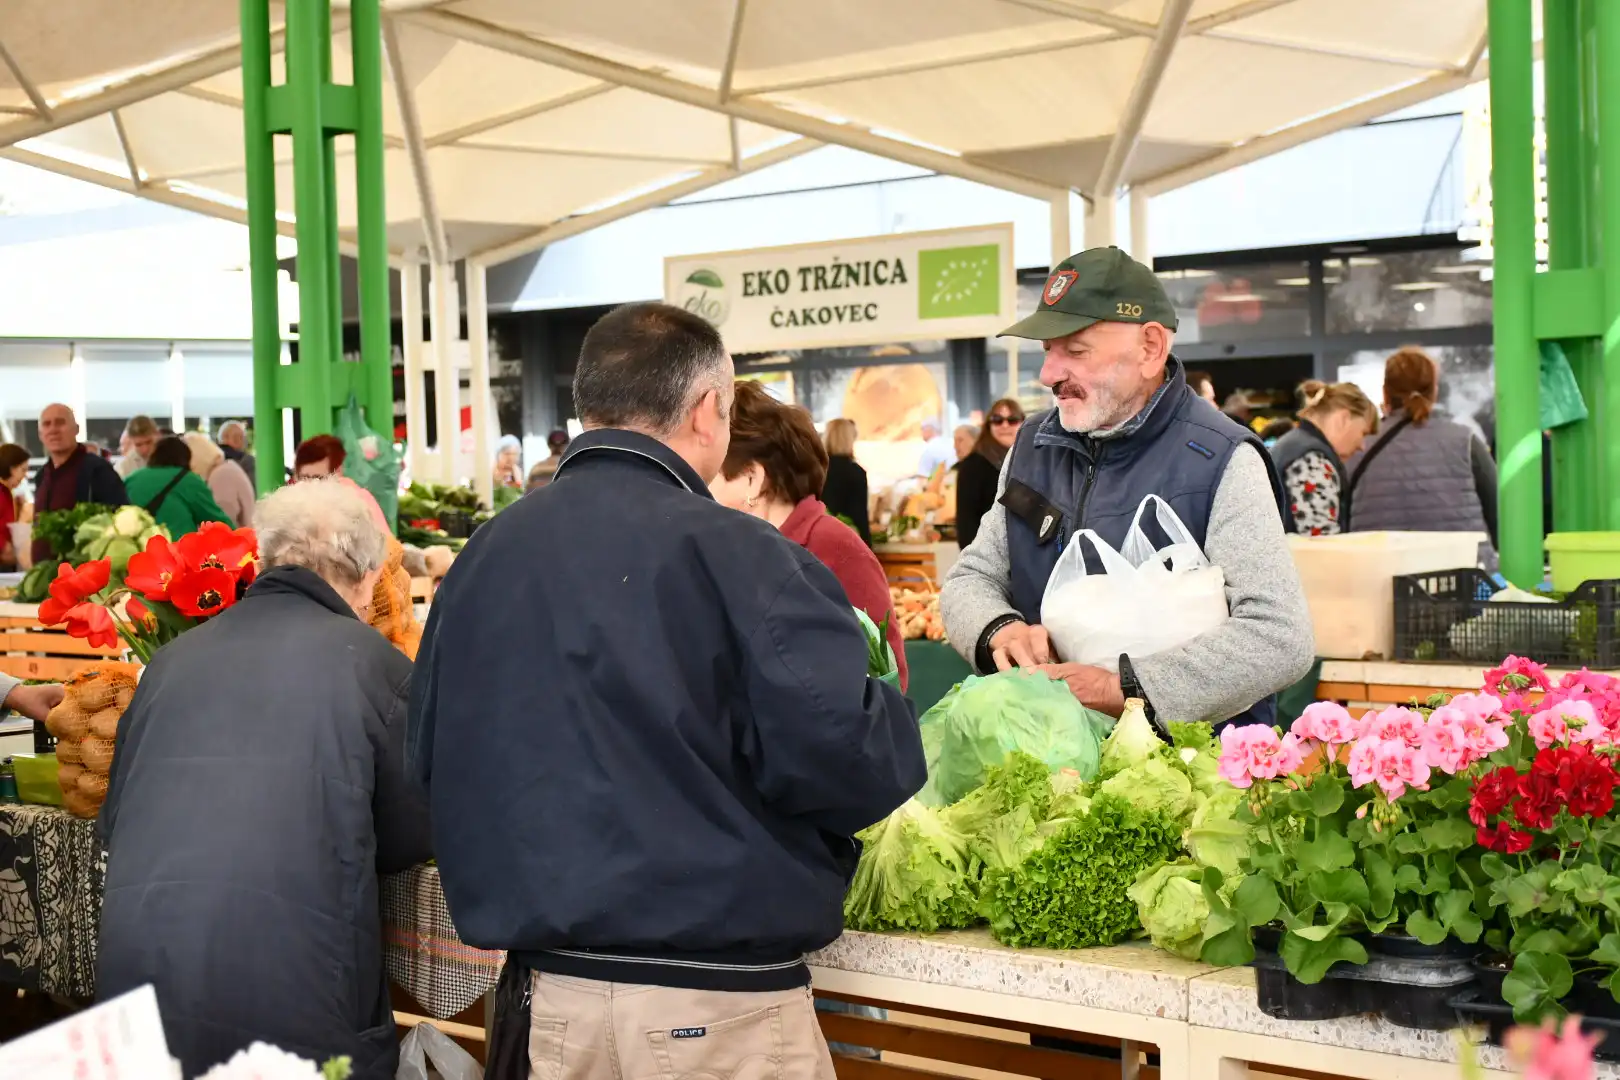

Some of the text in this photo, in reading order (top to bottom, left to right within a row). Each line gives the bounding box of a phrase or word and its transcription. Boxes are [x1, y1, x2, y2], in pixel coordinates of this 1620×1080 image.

[742, 256, 908, 297] EKO TRŽNICA
[770, 305, 878, 328] ČAKOVEC
[1116, 302, 1142, 317] 120
[672, 1029, 703, 1037] POLICE
